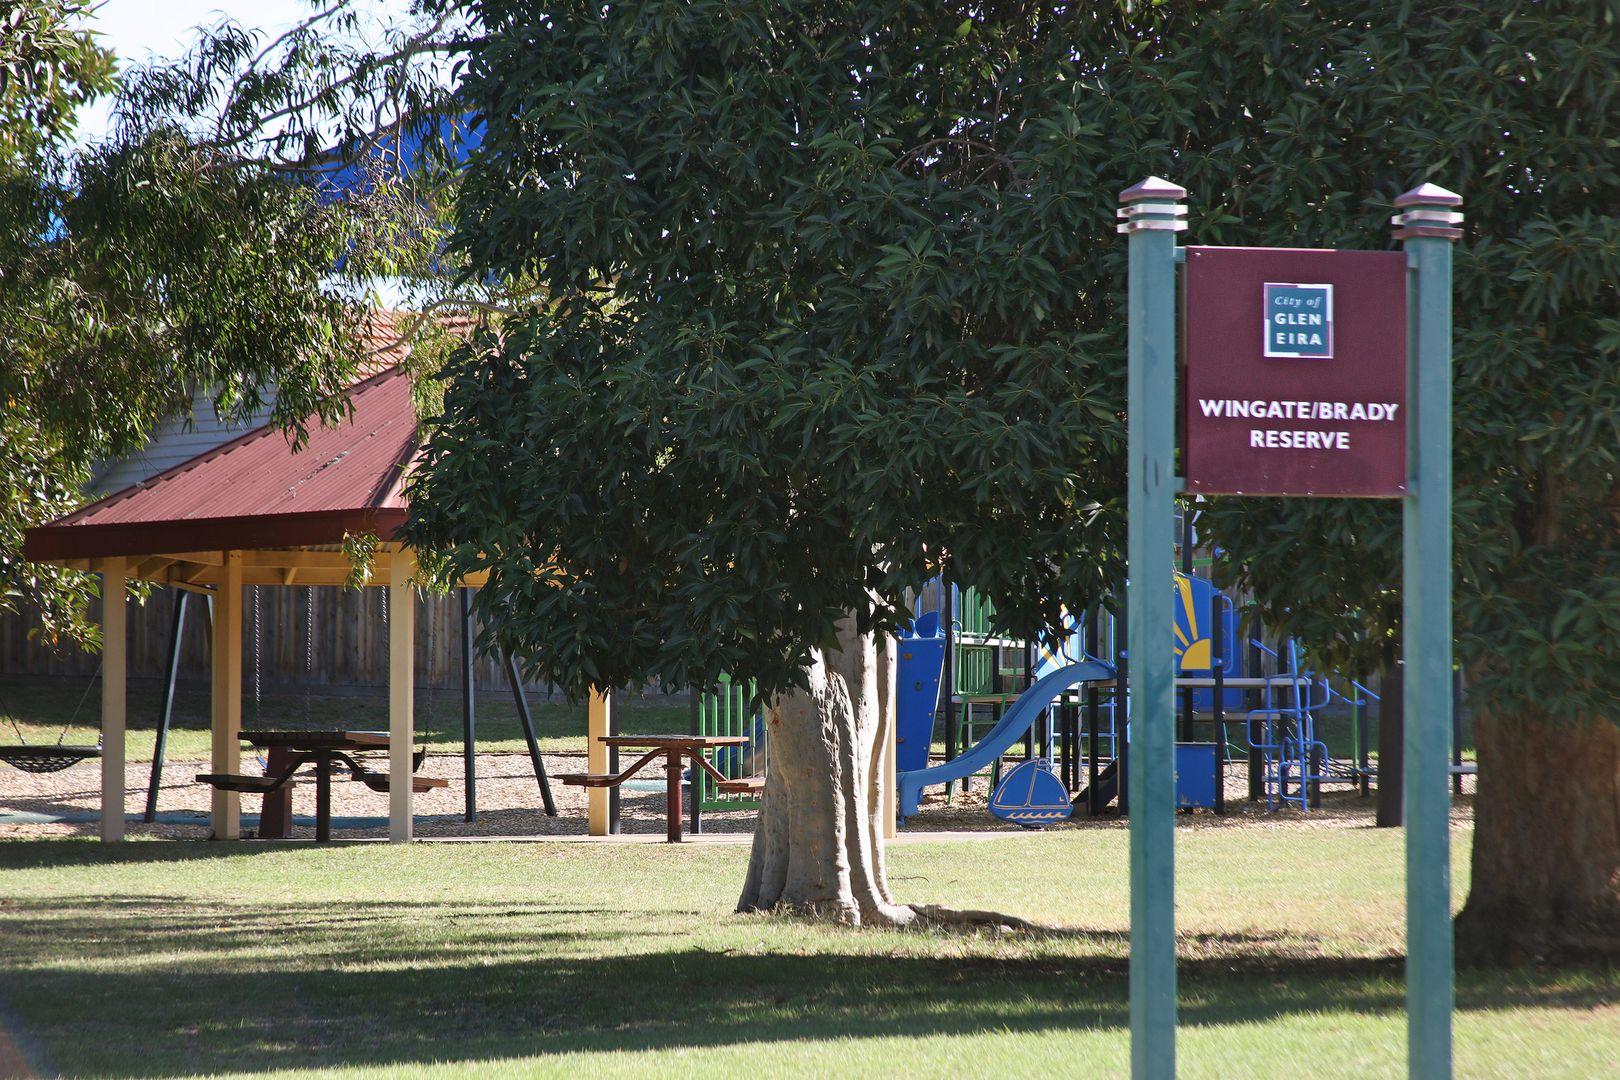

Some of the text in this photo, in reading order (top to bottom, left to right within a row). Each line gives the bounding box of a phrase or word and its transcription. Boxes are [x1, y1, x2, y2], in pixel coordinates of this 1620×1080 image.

[1274, 296, 1323, 308] City of
[1274, 312, 1322, 325] GLEN
[1276, 332, 1322, 345] EIRA
[1199, 399, 1399, 421] WINGATE/BRADY
[1250, 429, 1350, 449] RESERVE
